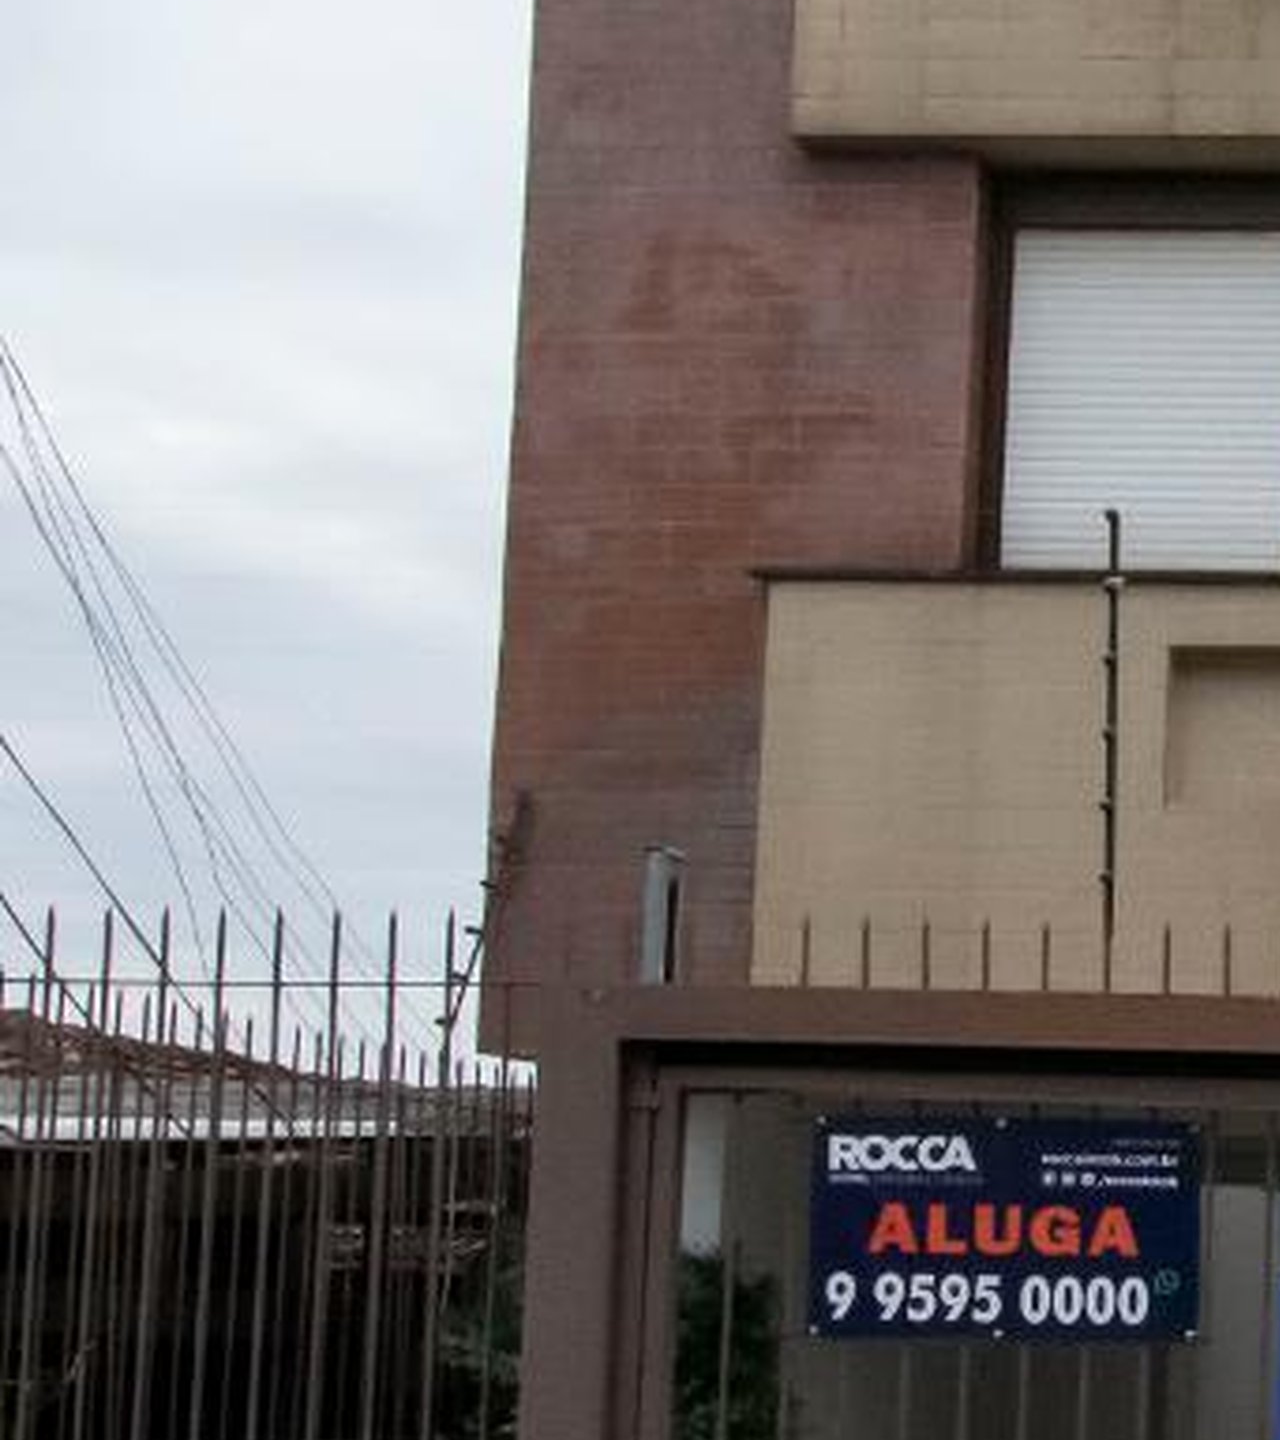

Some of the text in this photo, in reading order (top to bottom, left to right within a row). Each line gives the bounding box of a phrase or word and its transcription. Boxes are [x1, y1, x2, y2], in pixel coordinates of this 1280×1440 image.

[827, 1133, 978, 1171] ROCCA
[867, 1199, 1141, 1258] ALUGA
[825, 1270, 1150, 1326] 9 9595 0000
